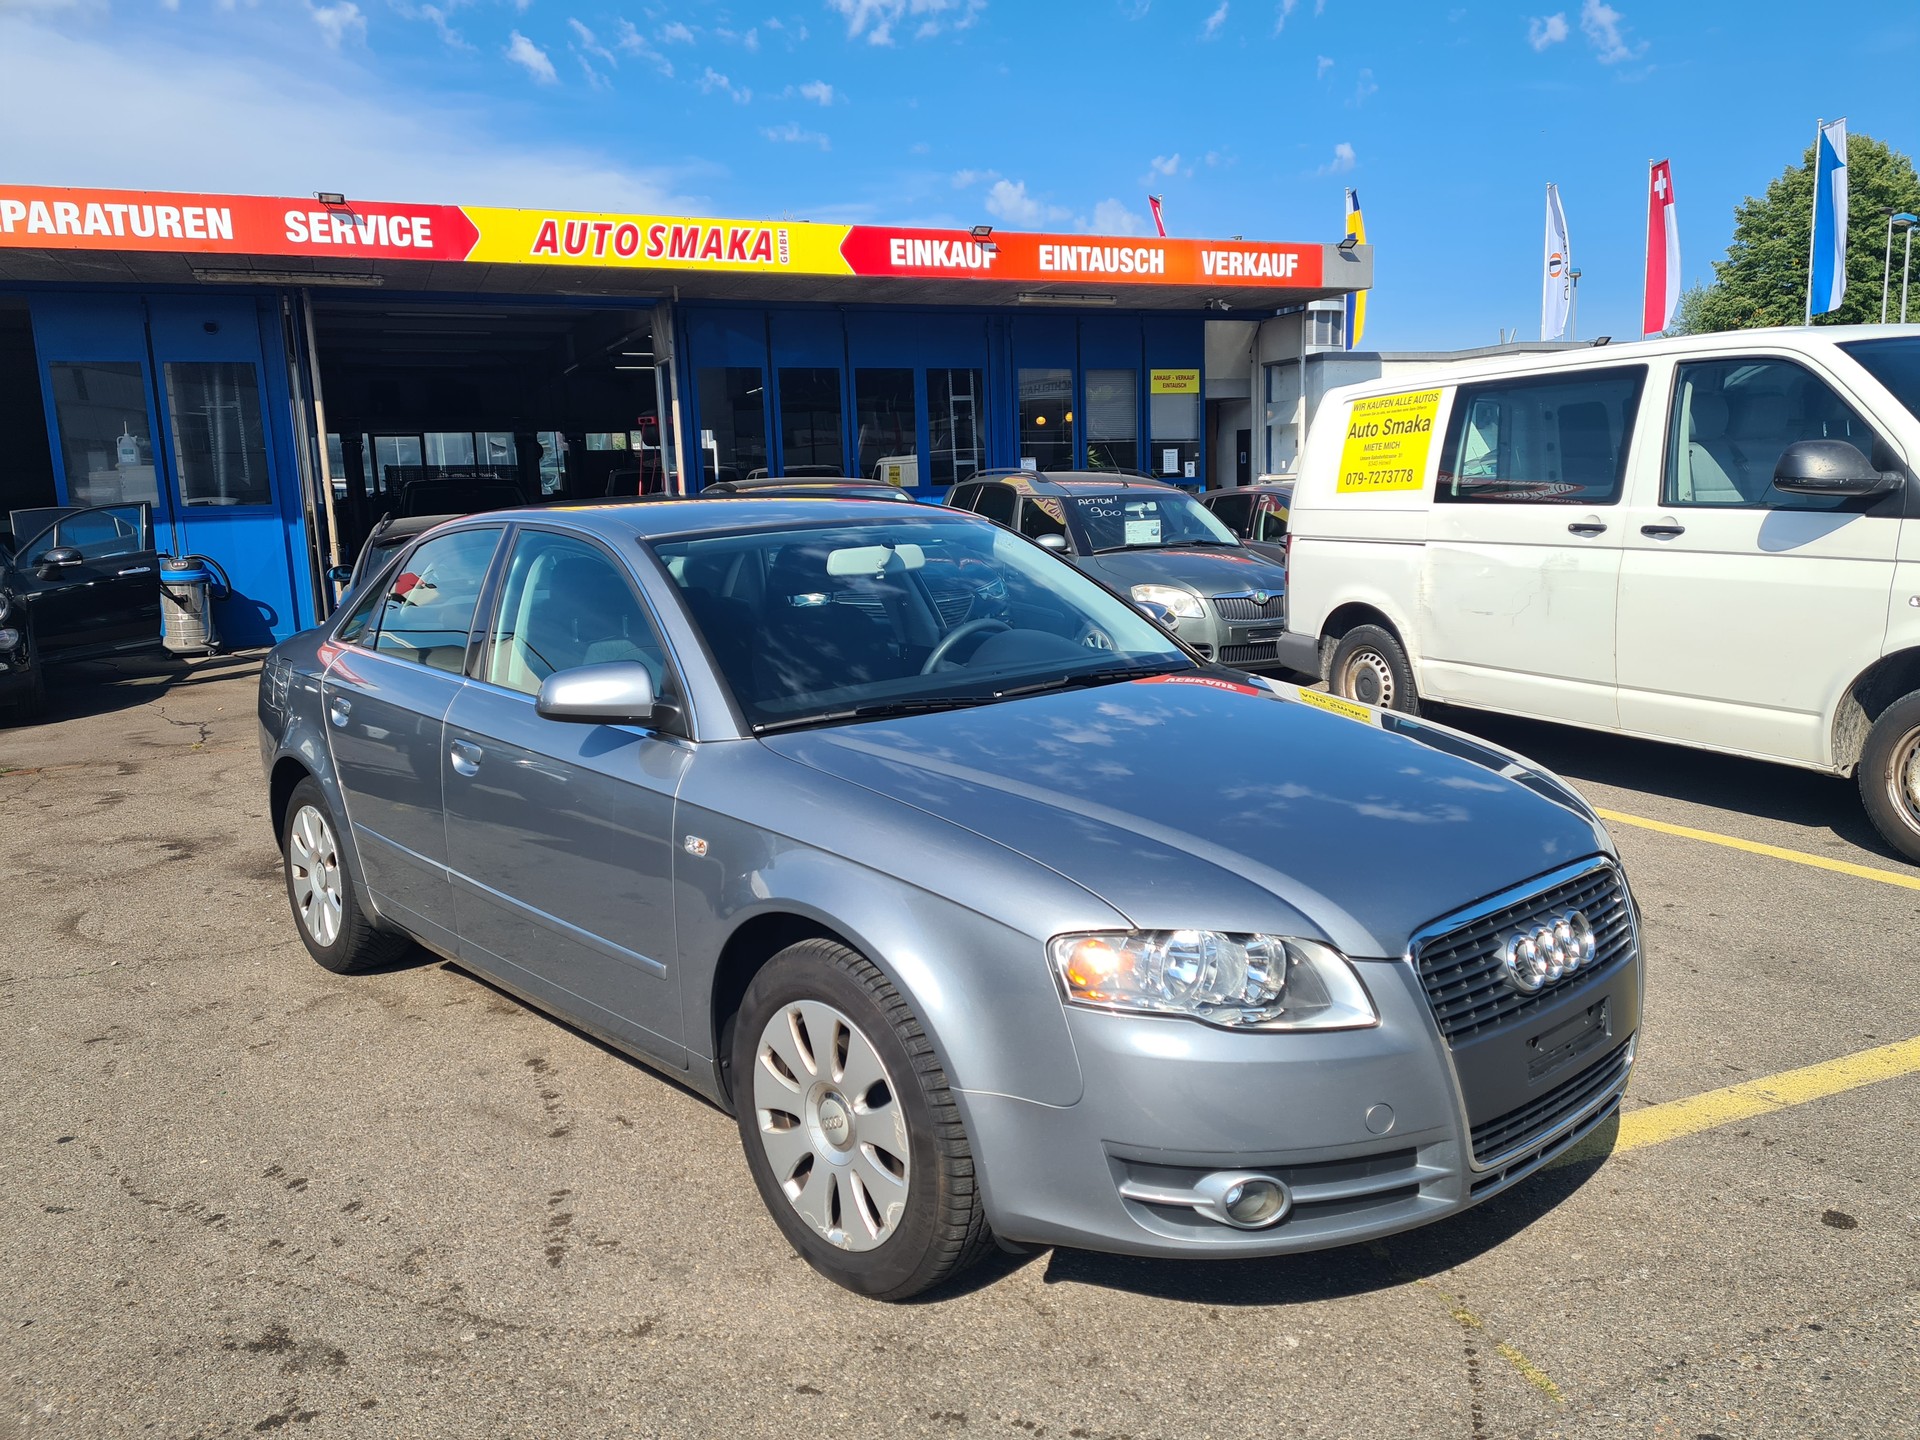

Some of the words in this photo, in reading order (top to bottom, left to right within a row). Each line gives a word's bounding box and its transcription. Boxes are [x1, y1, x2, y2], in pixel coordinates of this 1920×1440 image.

[0, 199, 234, 240] PARATUREN
[284, 210, 434, 248] SERVICE
[532, 220, 640, 257] AUTO
[646, 224, 774, 262] SMAKA
[779, 228, 789, 264] GMBH
[889, 237, 998, 269] EINKAUF
[1038, 244, 1165, 274] EINTAUSCH
[1201, 250, 1299, 278] VERKAUF
[1353, 402, 1366, 412] WIR
[1366, 399, 1395, 410] KAUFEN
[1394, 396, 1413, 408] ALLE
[1412, 392, 1440, 405] AUTOS
[1347, 421, 1379, 440] Auto
[1382, 414, 1432, 436] Smaka
[1363, 442, 1383, 453] MIETE
[1383, 441, 1401, 450] MICH
[1345, 468, 1414, 486] 079-7273778
